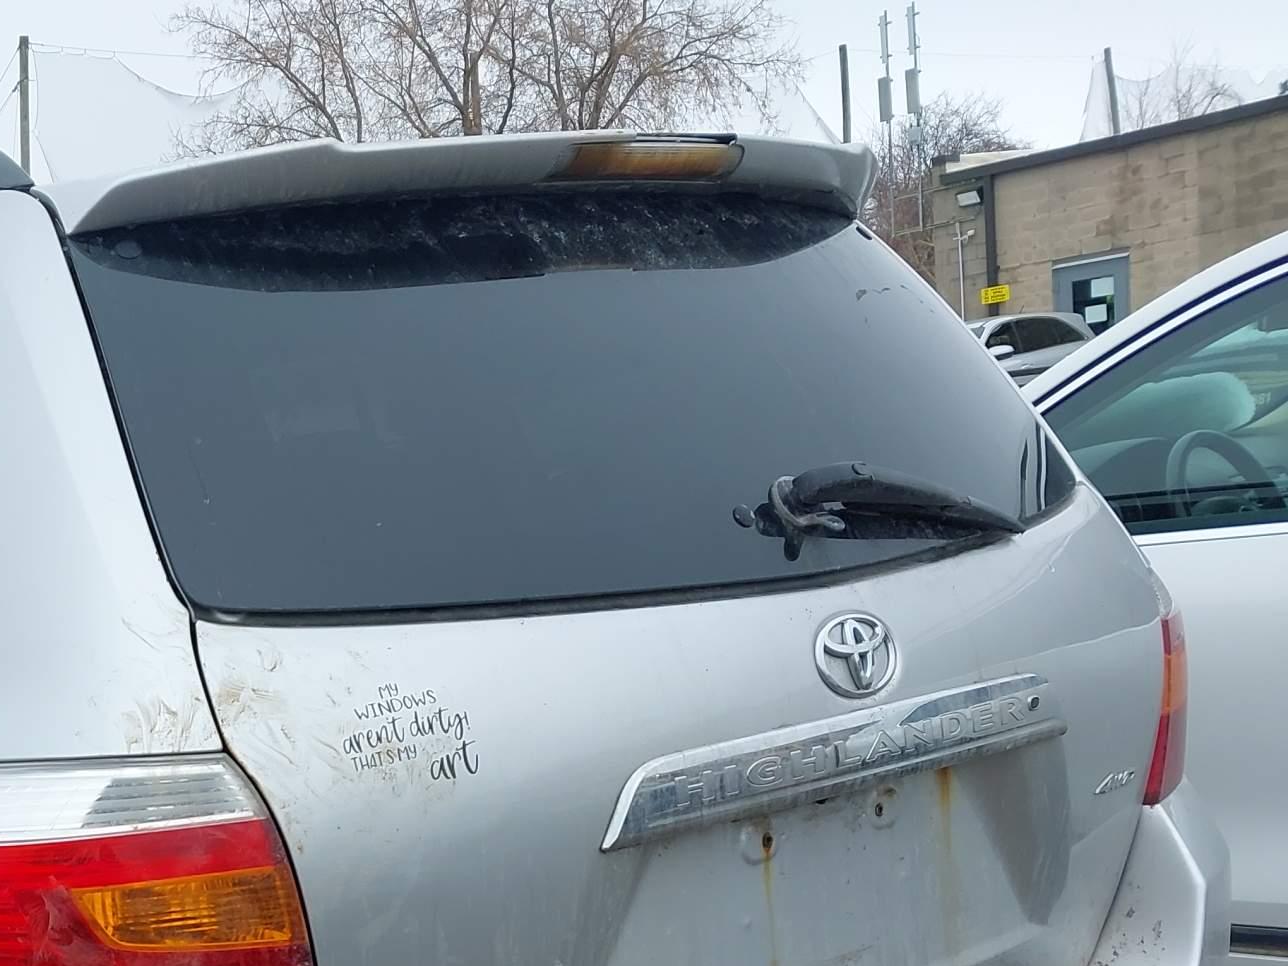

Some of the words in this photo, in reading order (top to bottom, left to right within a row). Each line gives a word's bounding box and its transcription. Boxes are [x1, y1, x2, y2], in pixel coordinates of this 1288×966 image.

[354, 689, 437, 720] WINDOWS
[409, 707, 471, 740] dirty!
[430, 740, 479, 781] art
[675, 696, 1025, 807] HIGHLANDER
